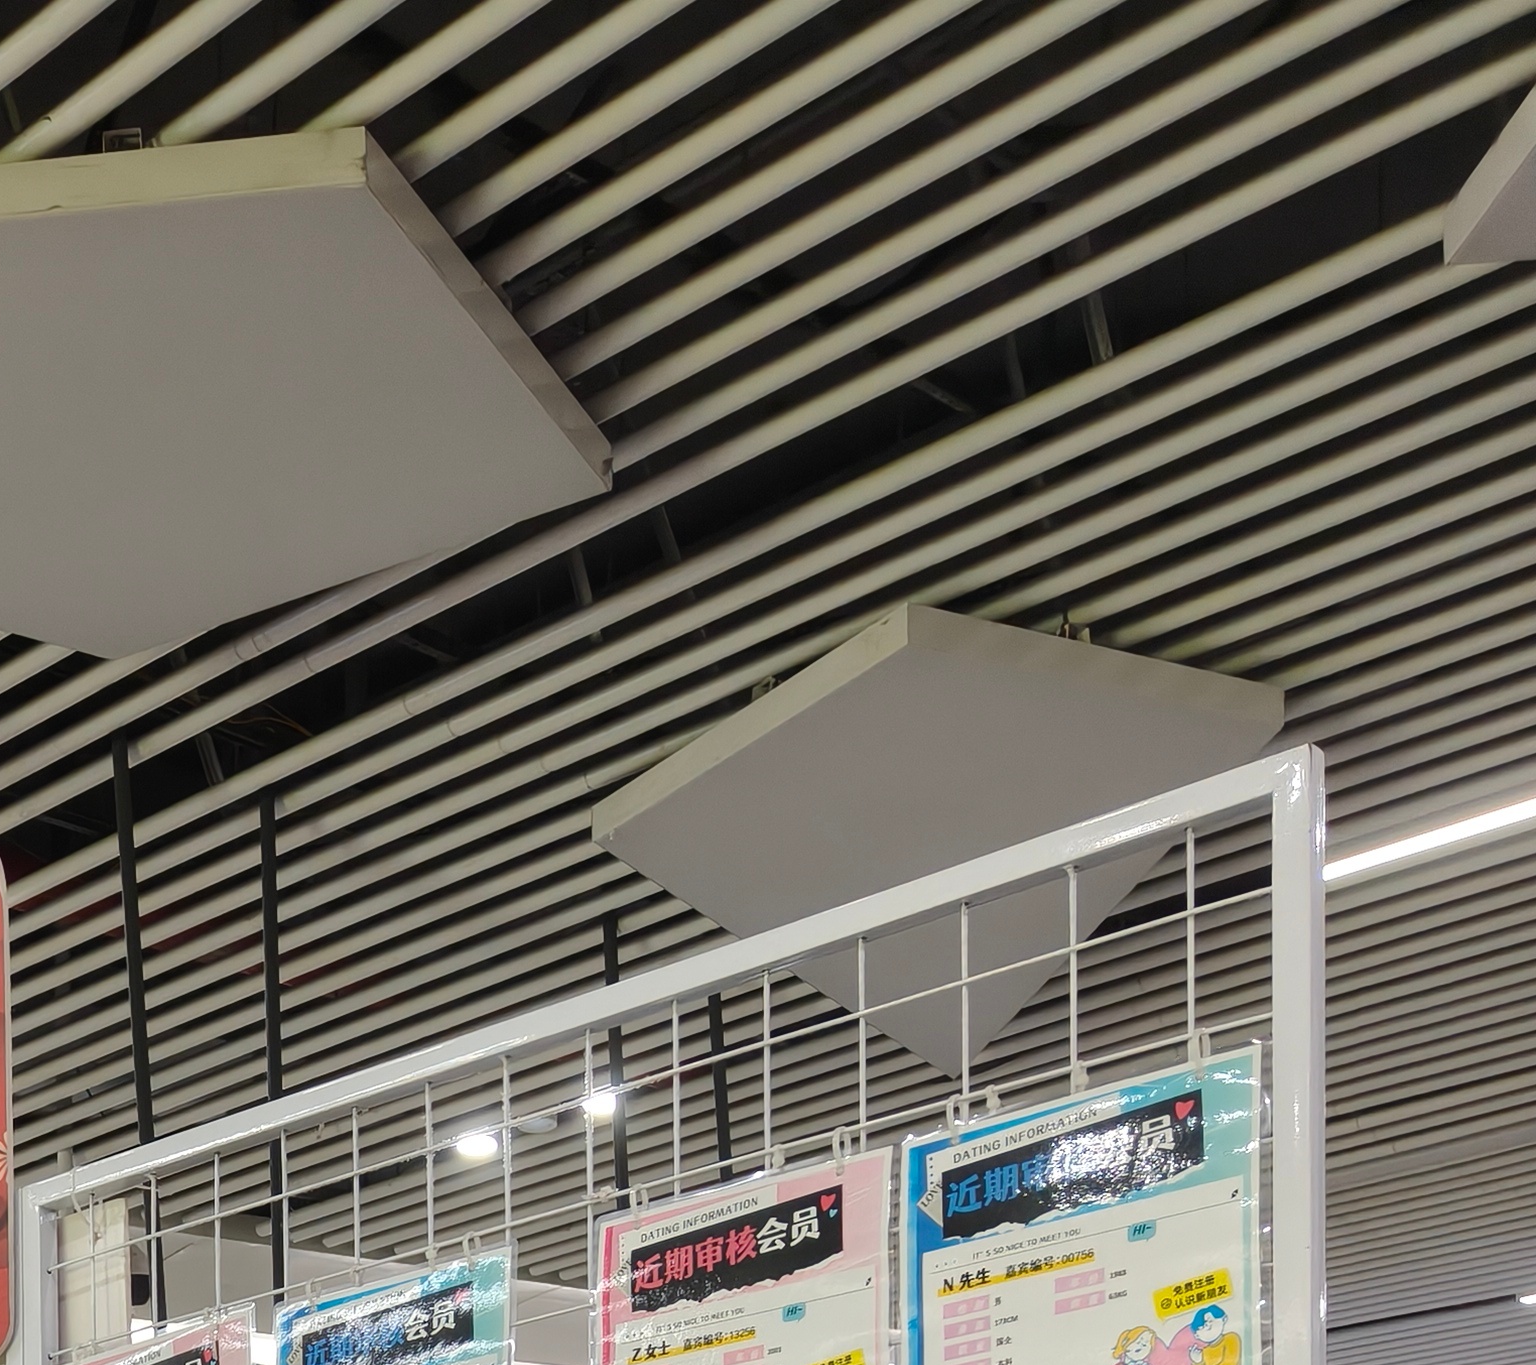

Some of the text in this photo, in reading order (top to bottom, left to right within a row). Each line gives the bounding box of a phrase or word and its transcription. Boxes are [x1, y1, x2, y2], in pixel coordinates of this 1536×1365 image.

[946, 1108, 1176, 1219] 近期审员
[635, 1201, 820, 1293] 近期审核会员
[640, 1195, 757, 1243] DATING INFORMATION
